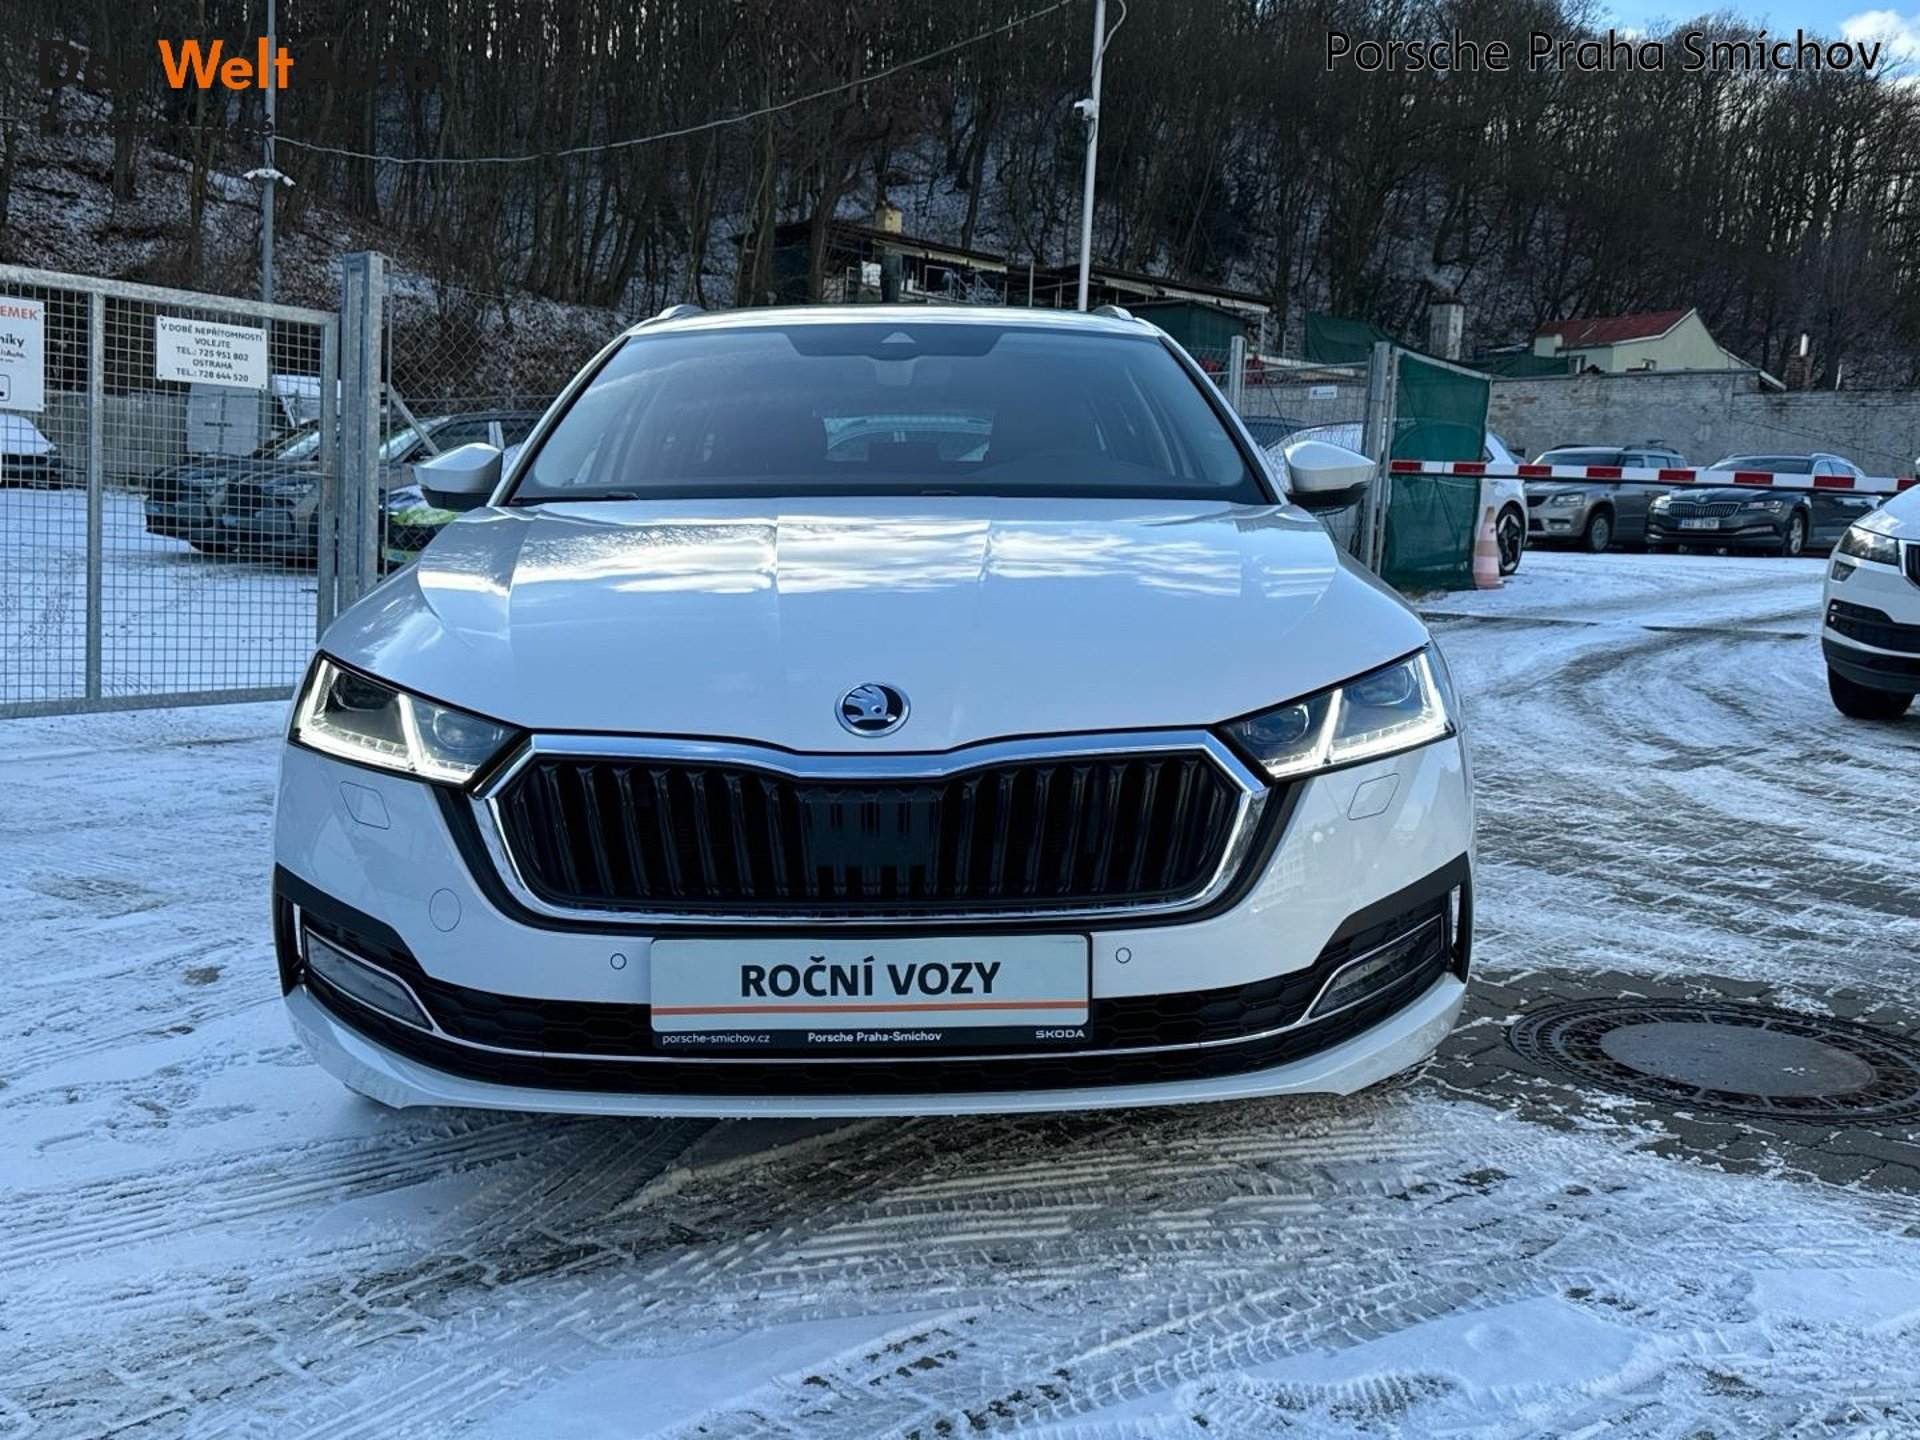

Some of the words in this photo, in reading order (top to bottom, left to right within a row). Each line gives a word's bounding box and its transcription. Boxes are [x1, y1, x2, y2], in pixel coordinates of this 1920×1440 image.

[160, 322, 167, 331] V
[169, 323, 193, 334] DOBĚ
[195, 326, 263, 342] NEPŘÍTOMNOSTI
[194, 338, 232, 349] VOLEJTE
[199, 348, 214, 358] 725
[216, 350, 231, 360] 951
[233, 352, 249, 362] 802
[192, 359, 233, 370] OSTRAHA
[199, 369, 214, 379] 728
[216, 371, 232, 381] 644
[233, 374, 249, 383] 520
[740, 955, 874, 998] ROČNÍ
[887, 961, 1002, 996] VOZY
[662, 1033, 771, 1046] porsche-smichov.cz
[808, 1032, 854, 1043] Porsche
